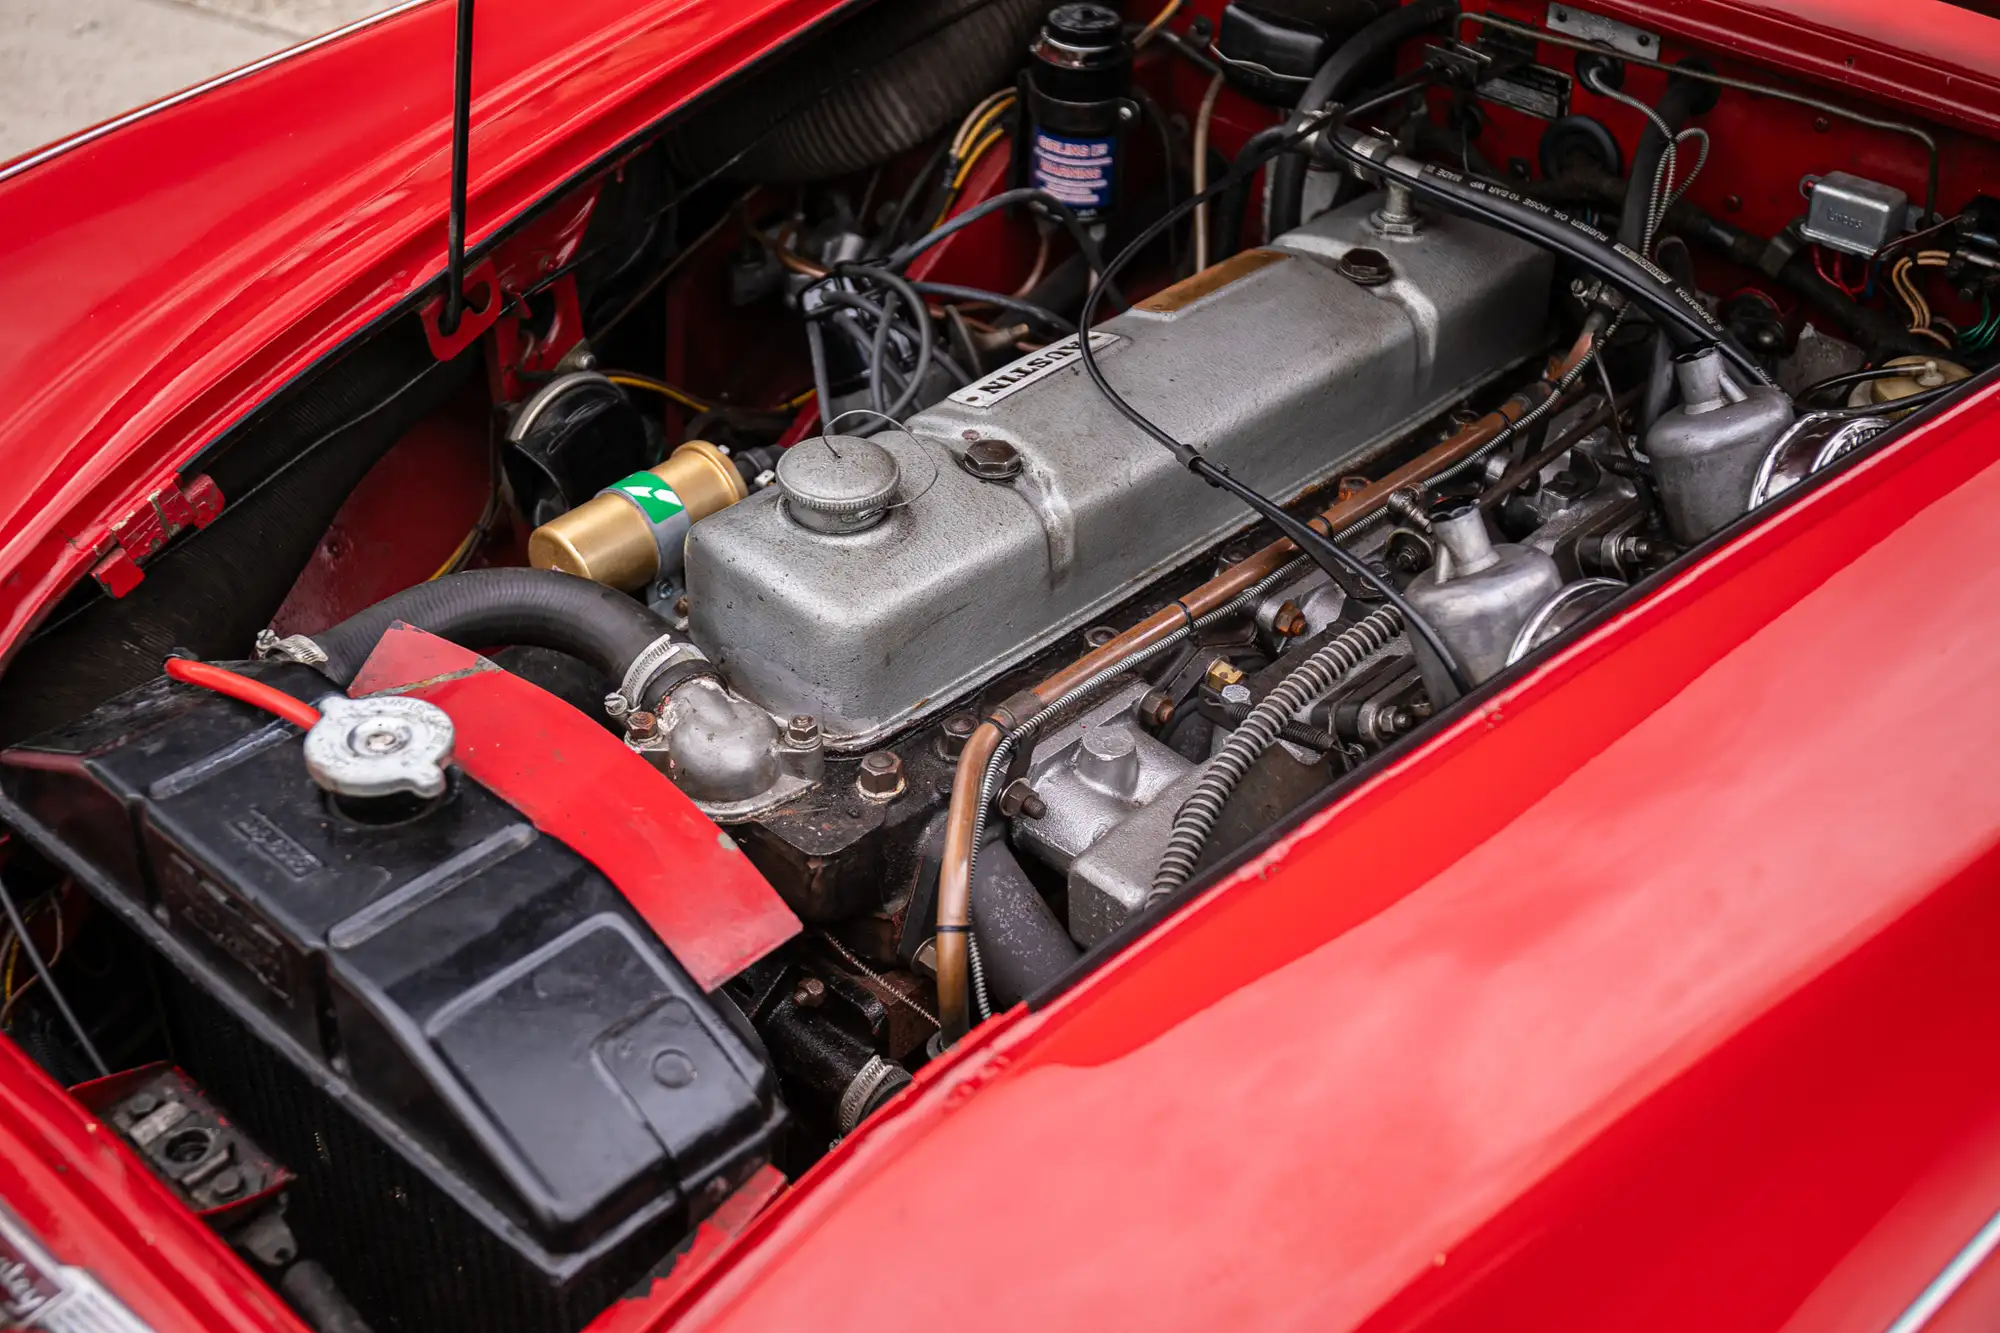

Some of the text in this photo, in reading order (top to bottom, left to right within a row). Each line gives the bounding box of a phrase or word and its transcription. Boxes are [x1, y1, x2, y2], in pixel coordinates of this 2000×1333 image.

[1436, 168, 1463, 182] MADE
[1469, 181, 1486, 190] WP
[1488, 186, 1509, 197] BAR
[1509, 192, 1520, 201] 10
[1522, 197, 1550, 214] HOSE
[1553, 209, 1569, 221] OIL
[1570, 218, 1609, 242] RUBBER
[1636, 256, 1670, 282] CARBOIL
[1675, 287, 1717, 325] RAPISARDA
